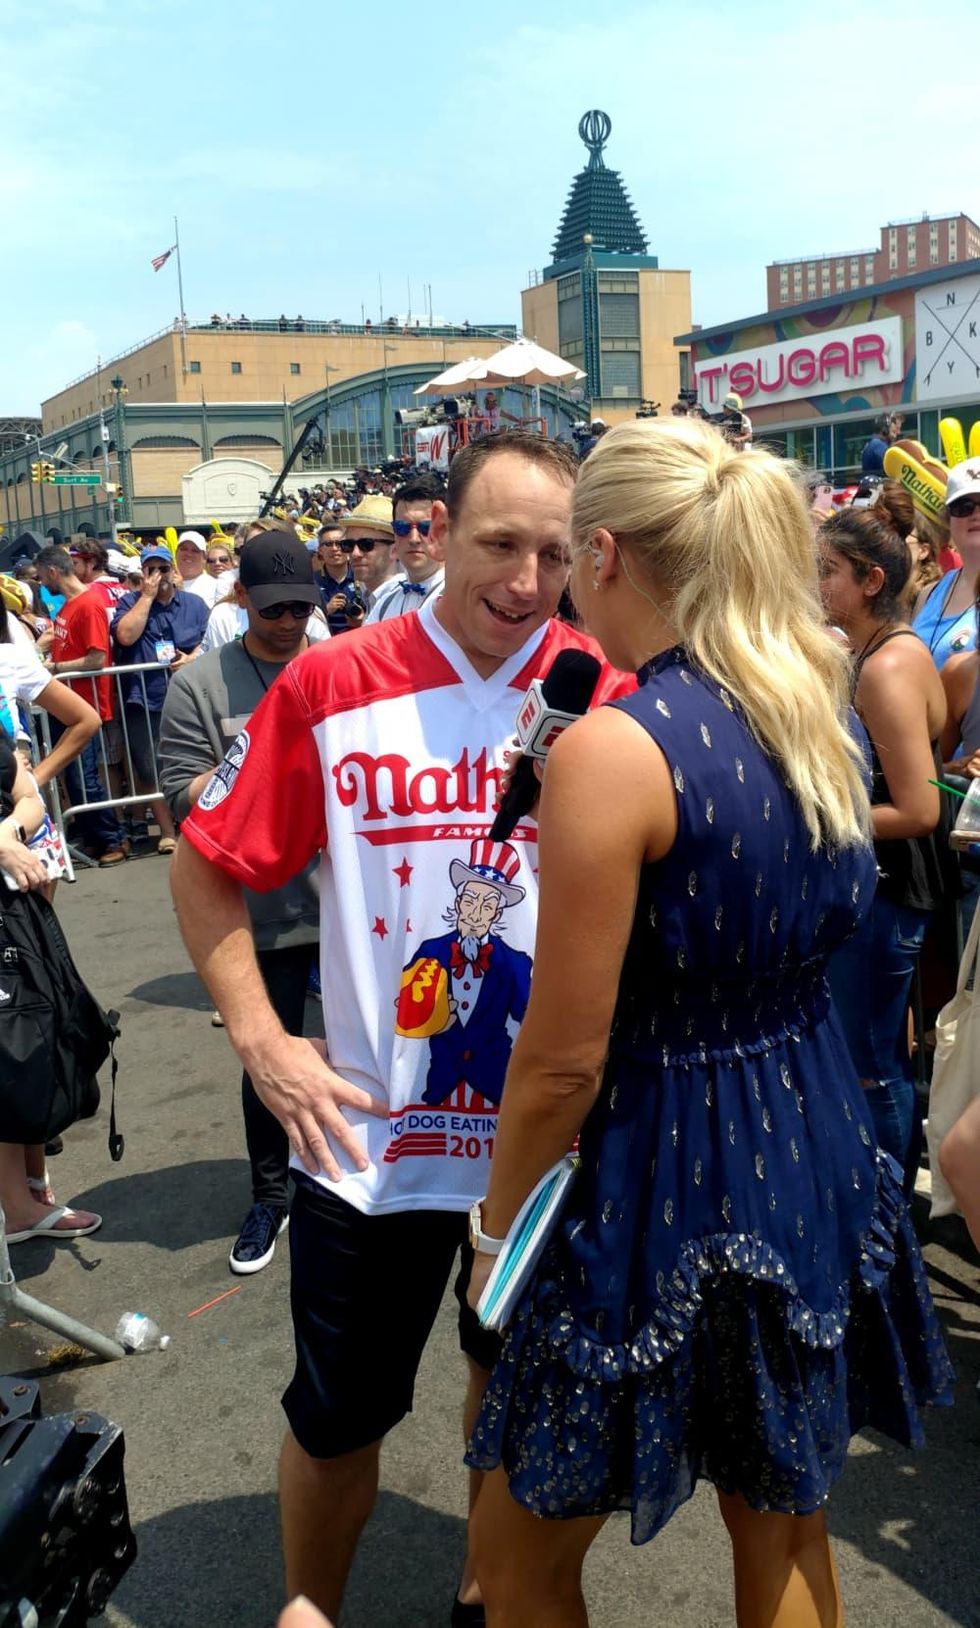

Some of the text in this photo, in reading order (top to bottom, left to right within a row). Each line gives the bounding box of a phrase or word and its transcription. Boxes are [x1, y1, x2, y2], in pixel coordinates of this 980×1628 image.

[946, 291, 956, 306] N
[968, 321, 977, 338] K
[925, 331, 933, 346] B
[946, 360, 955, 374] Y
[332, 747, 507, 821] Nath
[433, 827, 528, 838] FAMS
[408, 1115, 446, 1129] DOG
[450, 1116, 498, 1132] EATIN
[450, 1135, 494, 1160] 201
